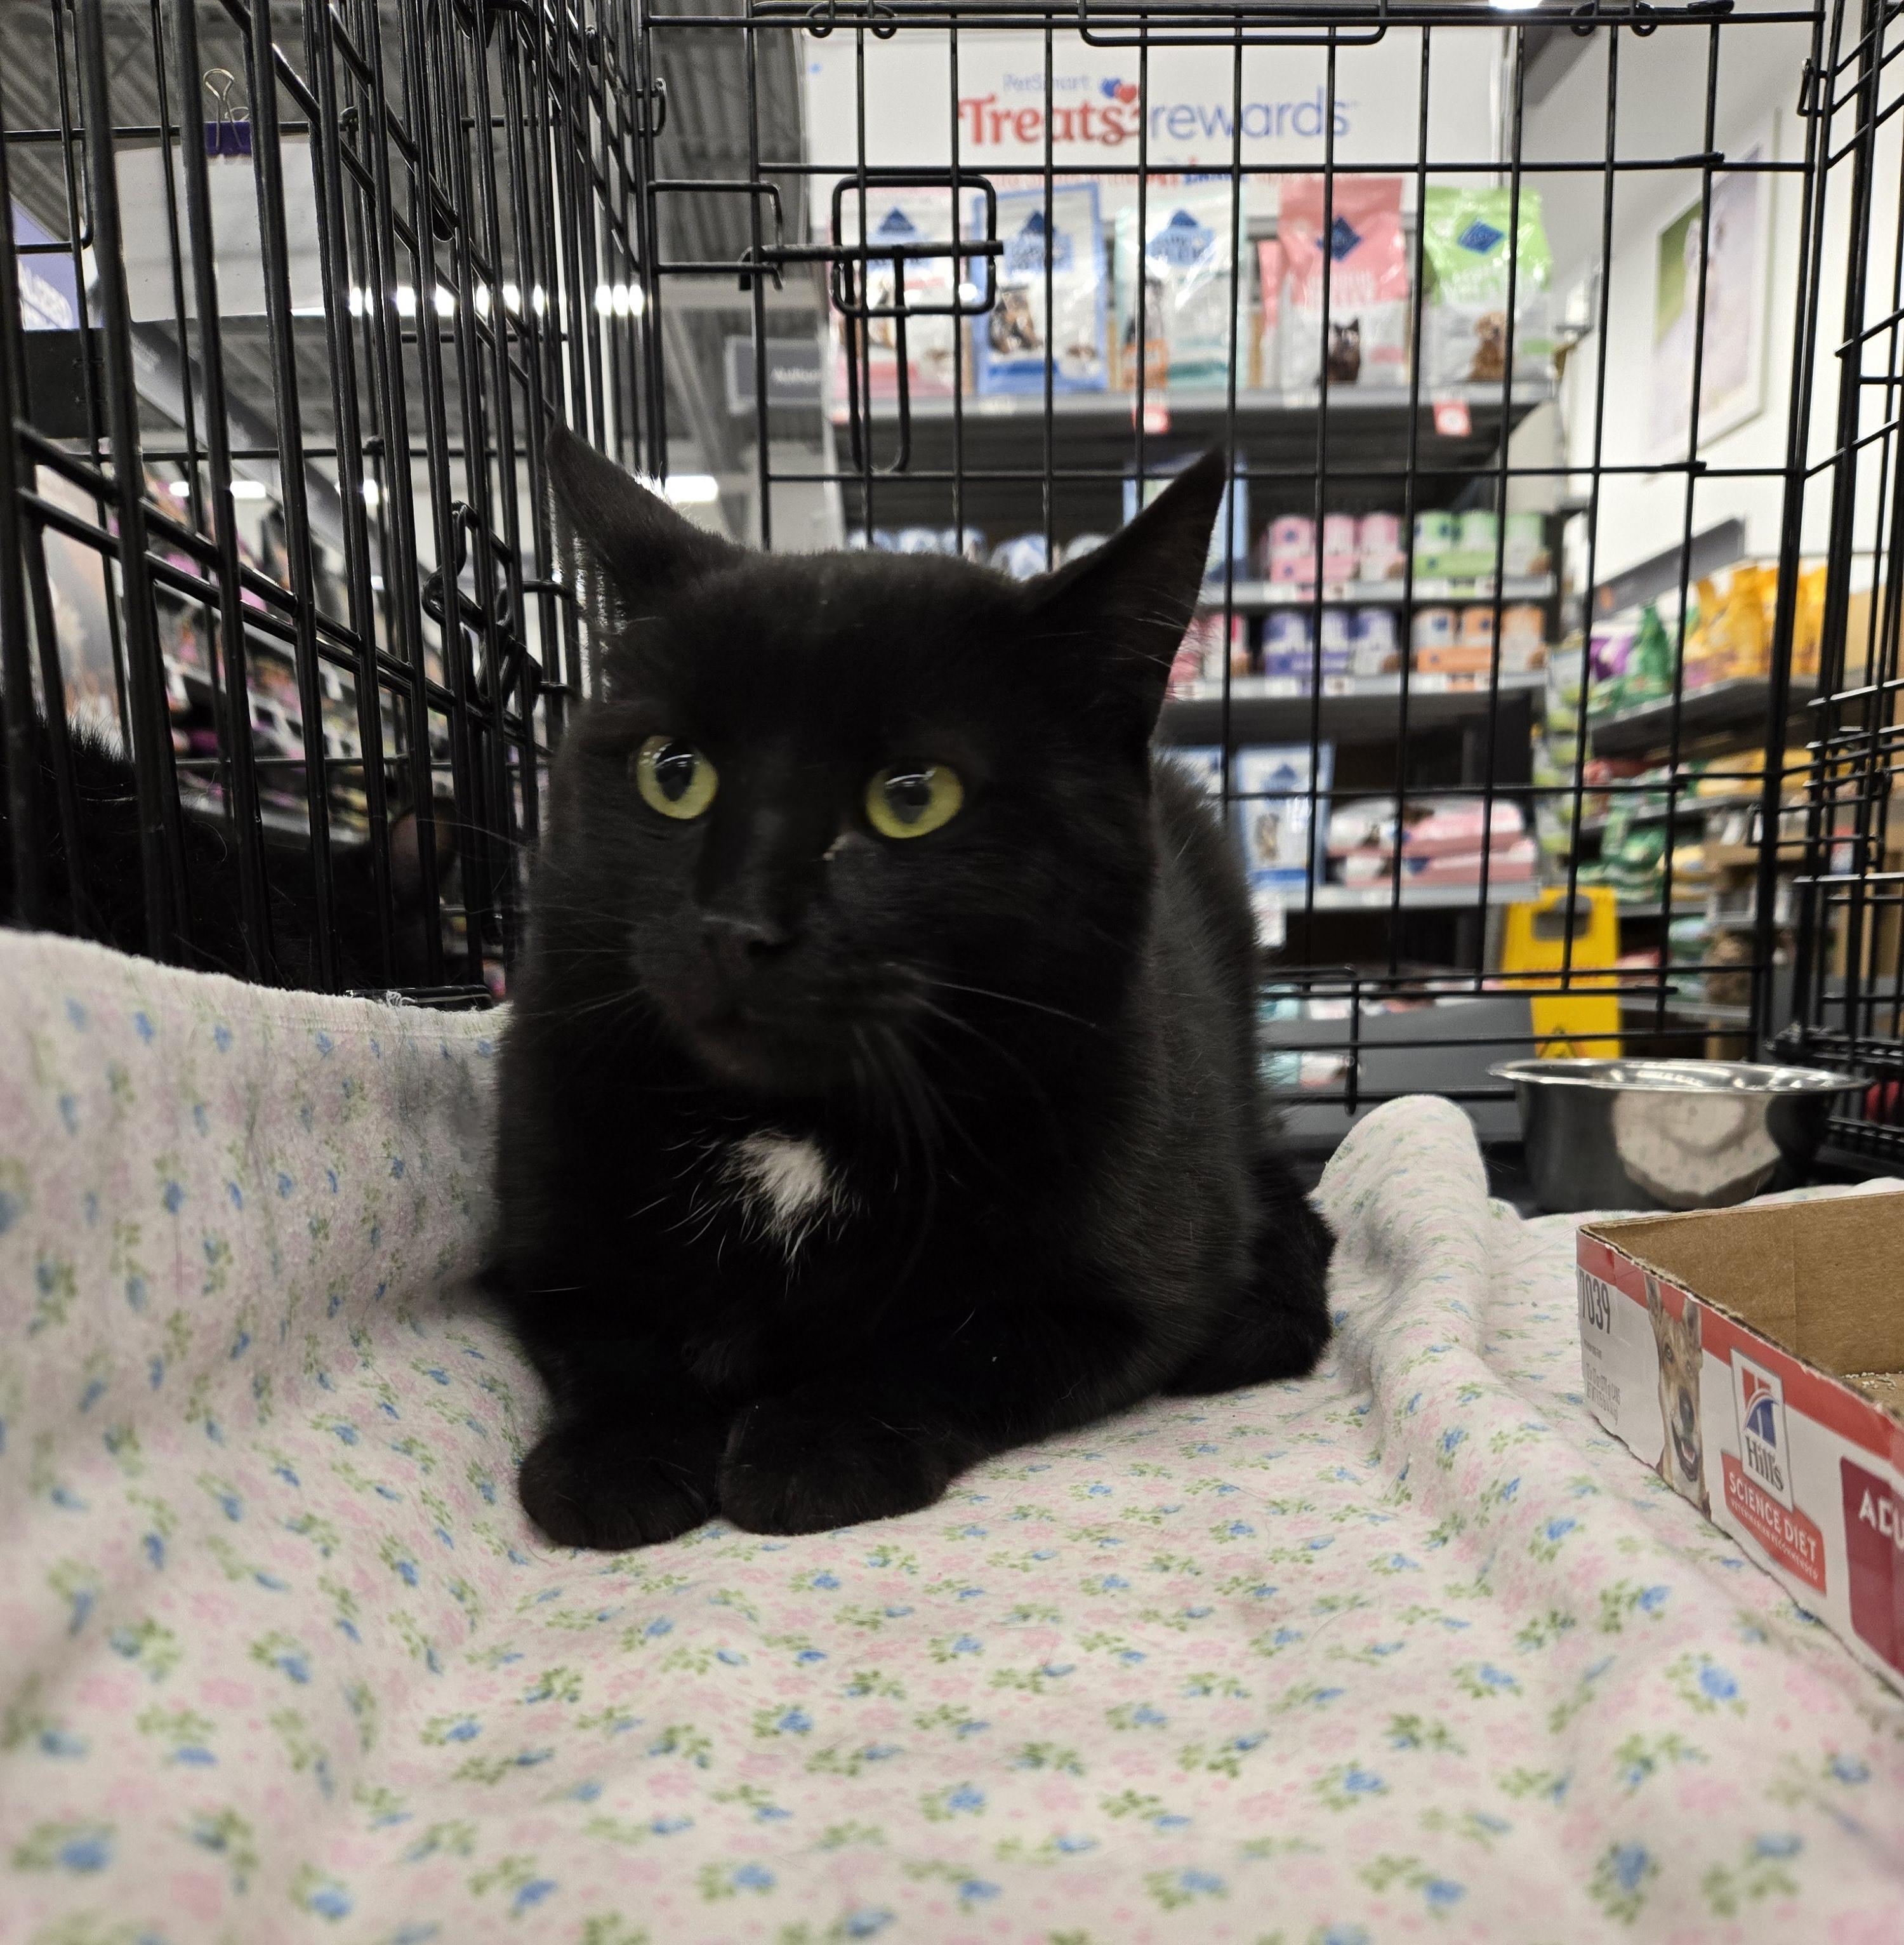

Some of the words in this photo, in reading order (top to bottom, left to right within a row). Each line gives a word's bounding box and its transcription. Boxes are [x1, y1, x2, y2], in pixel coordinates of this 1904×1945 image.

[957, 93, 1139, 147] Treats
[1150, 84, 1351, 140] rewards
[1579, 1269, 1611, 1334] 7039
[1728, 1470, 1783, 1536] SCIENCE
[1783, 1518, 1817, 1563] DIET
